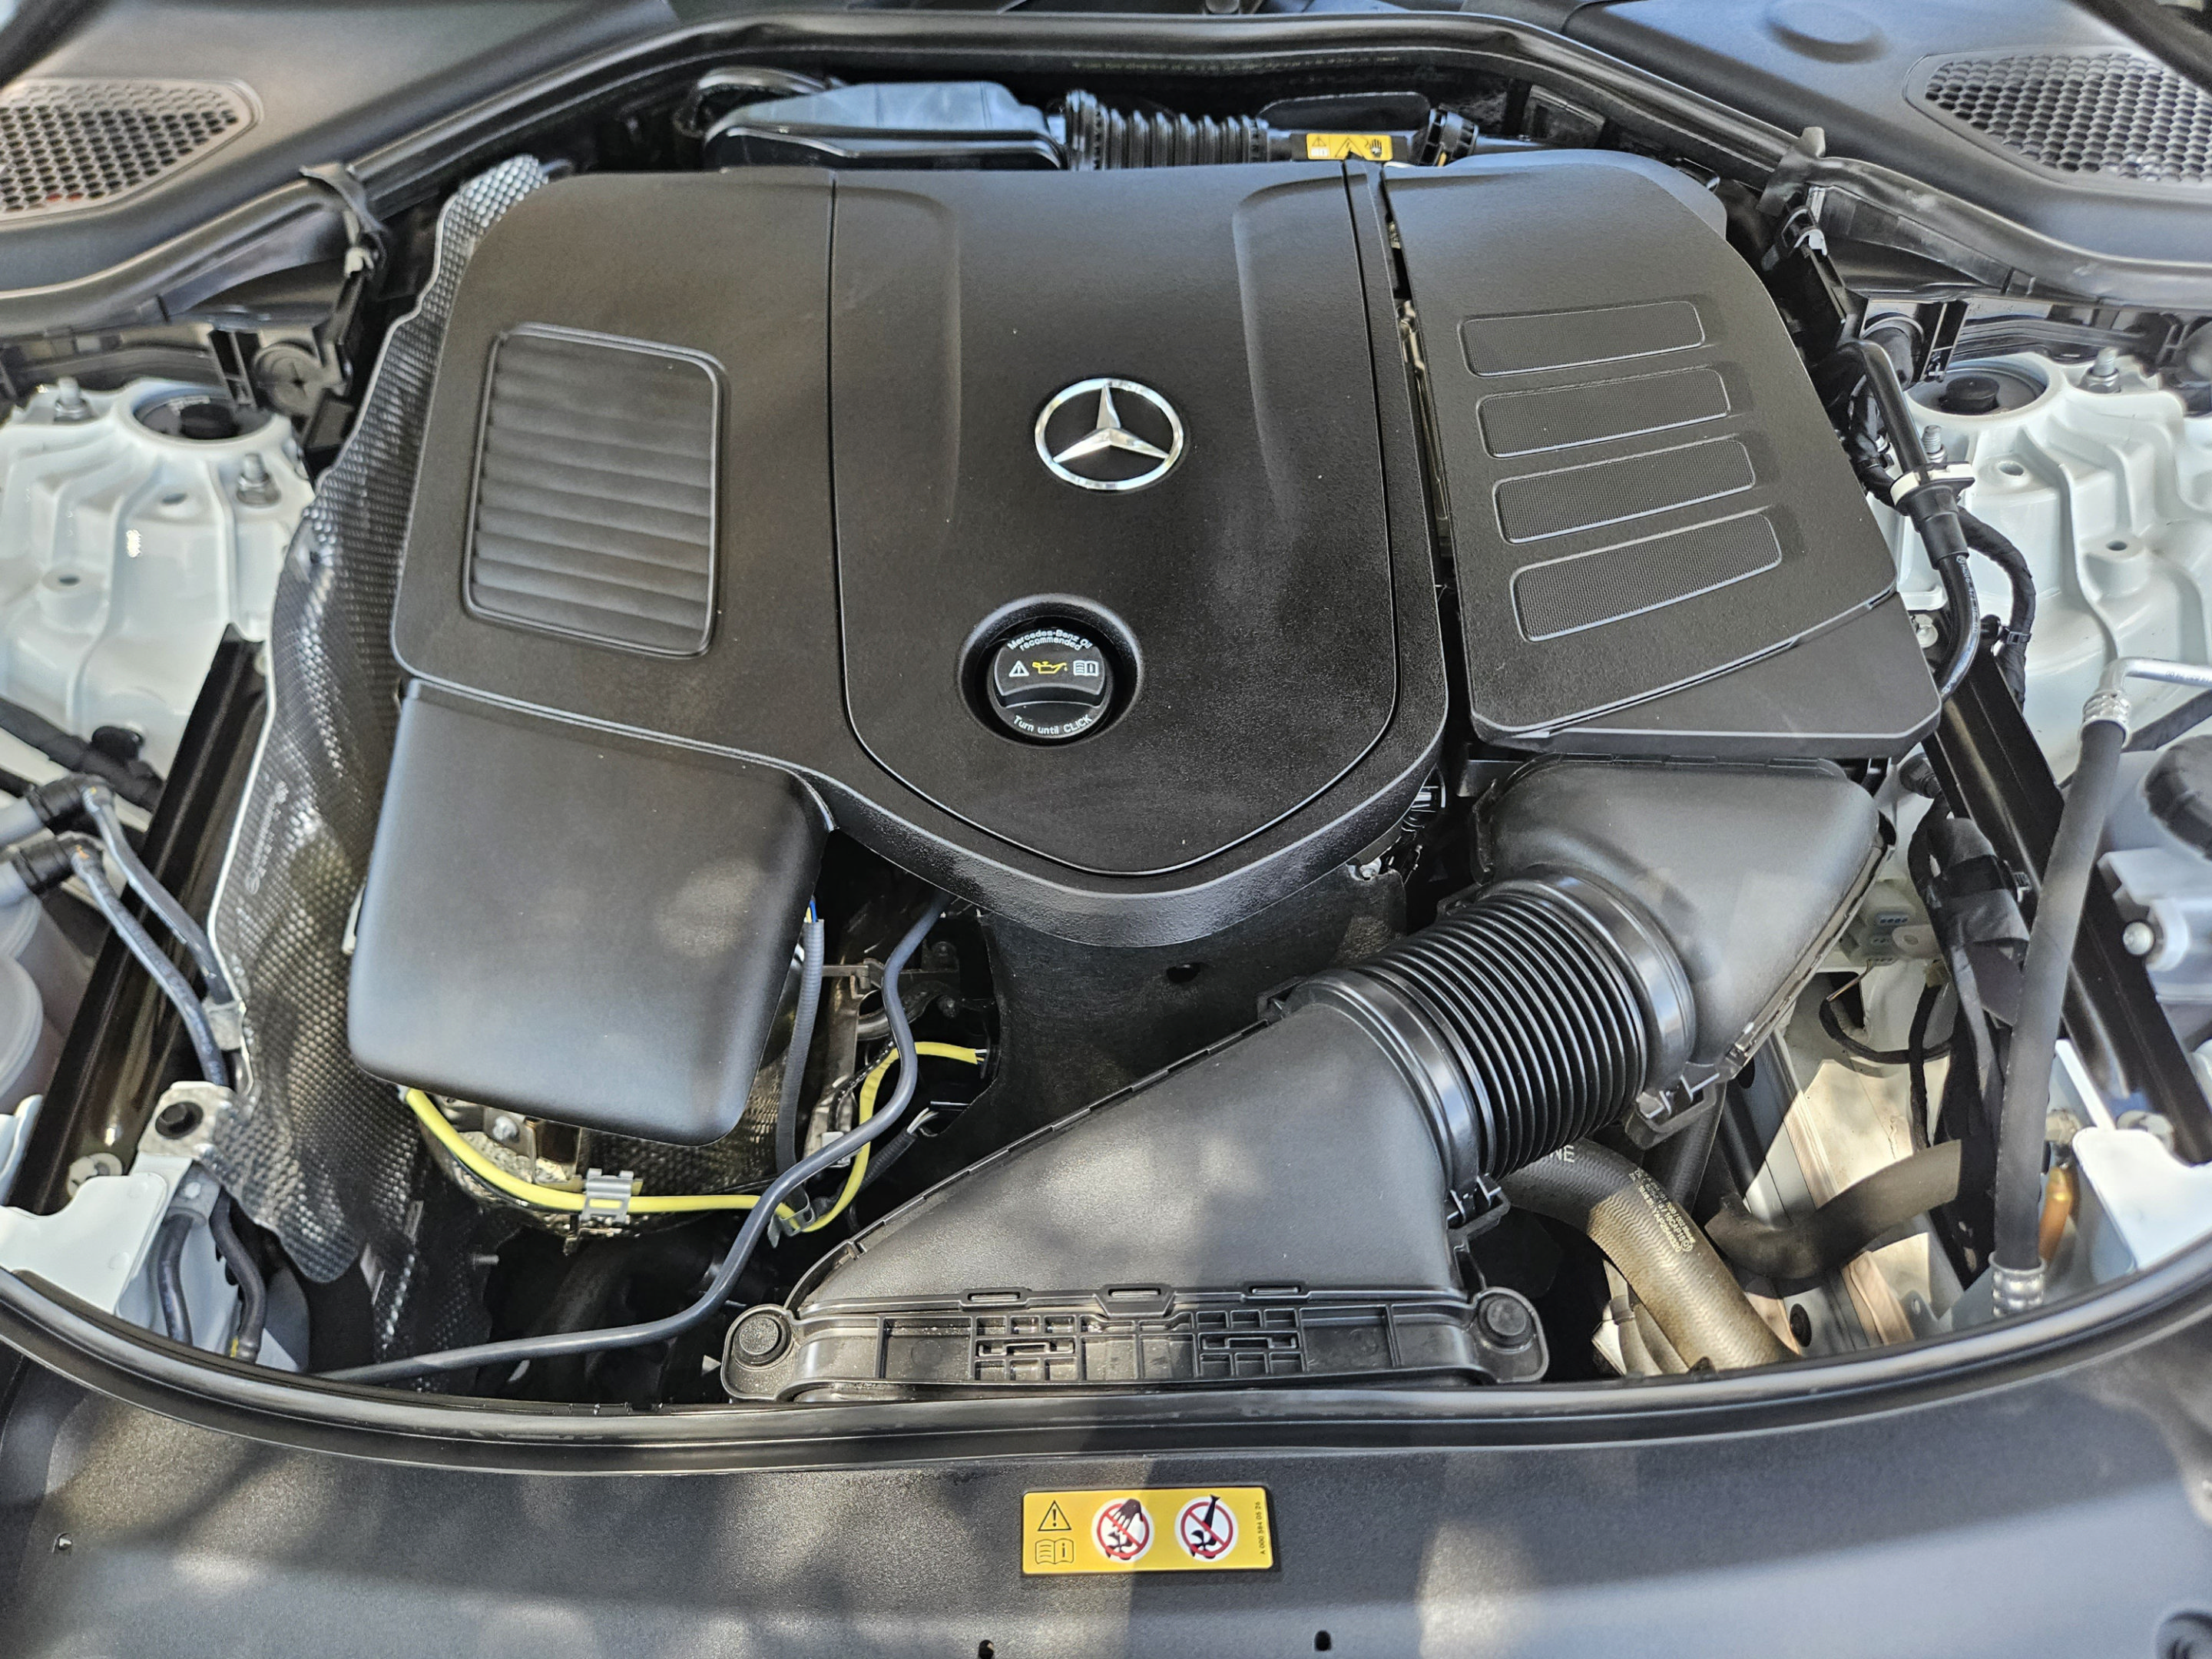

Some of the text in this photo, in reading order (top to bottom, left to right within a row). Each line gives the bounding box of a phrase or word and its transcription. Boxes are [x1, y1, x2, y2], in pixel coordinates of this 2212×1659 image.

[1007, 629, 1093, 650] Mercedes-Benz Oil
[1019, 637, 1082, 651] recommended
[1014, 714, 1093, 734] Turn until CLICK
